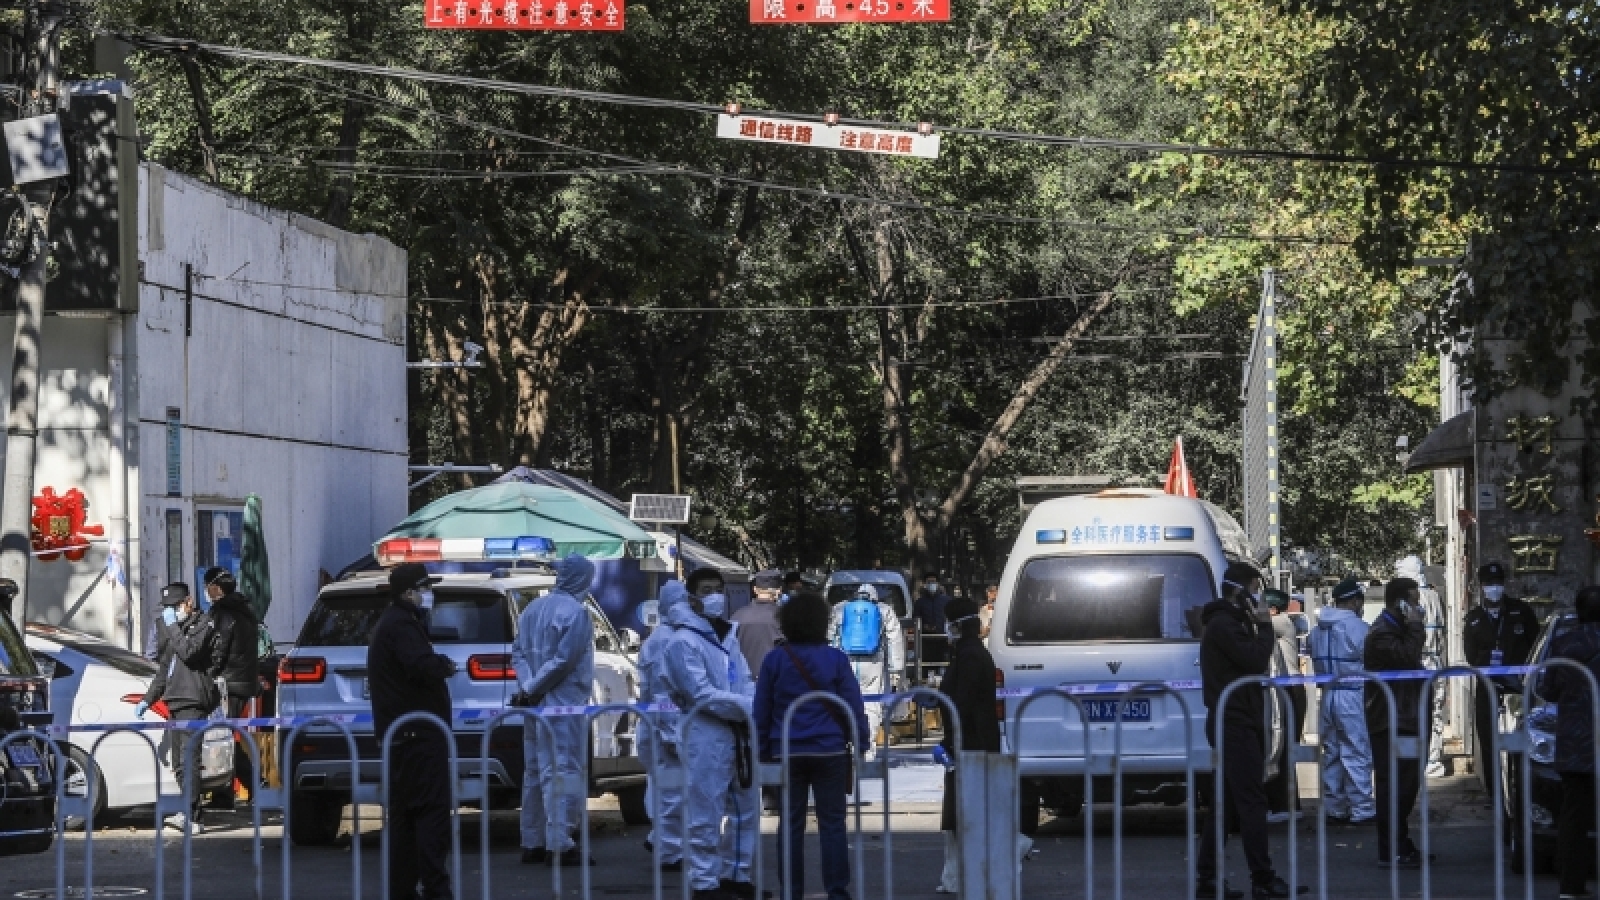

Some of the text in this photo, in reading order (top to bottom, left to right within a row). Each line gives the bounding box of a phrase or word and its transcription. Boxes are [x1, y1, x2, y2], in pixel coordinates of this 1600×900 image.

[430, 0, 619, 26] 上有光缆注意安全
[740, 119, 912, 153] 通信线路 注意高度
[1071, 523, 1161, 545] 全科医疗服务车
